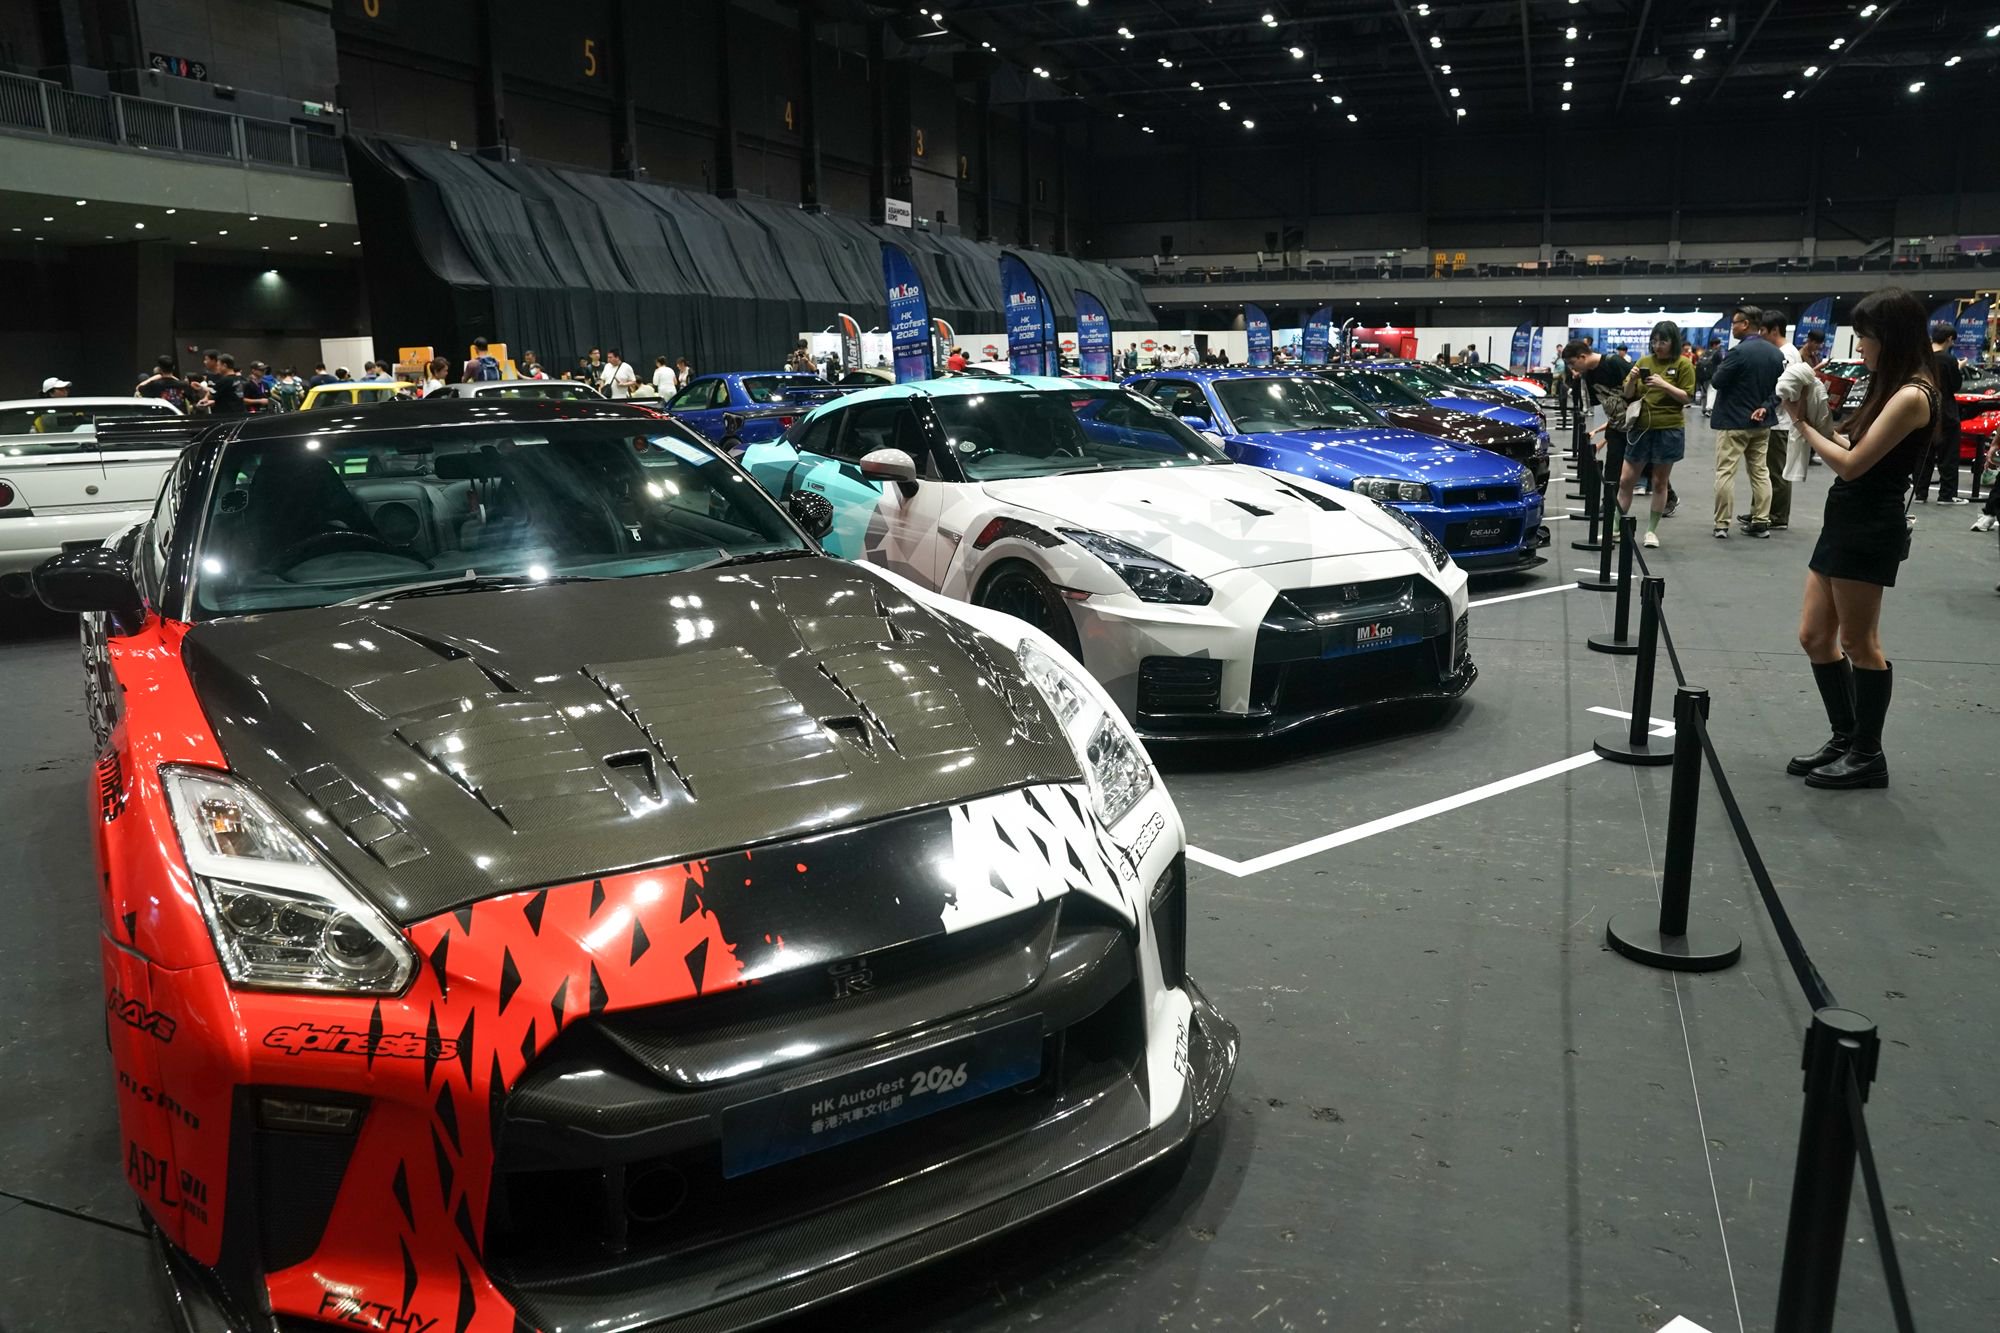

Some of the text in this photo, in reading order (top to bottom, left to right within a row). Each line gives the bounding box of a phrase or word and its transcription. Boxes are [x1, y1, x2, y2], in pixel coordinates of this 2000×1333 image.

[584, 39, 597, 77] 5
[785, 101, 793, 130] 4
[916, 129, 924, 156] 3
[961, 155, 968, 179] 2
[889, 283, 919, 299] MXpo
[891, 318, 926, 331] utofest
[900, 310, 913, 321] HK
[1020, 316, 1030, 324] HK
[895, 328, 919, 340] 2026
[1018, 331, 1035, 341] 2026
[1607, 328, 1619, 336] HK
[1356, 623, 1393, 641] IMXpo
[108, 986, 177, 1044] RAYS
[262, 1022, 464, 1060] alpinestars
[811, 1062, 968, 1117] HK Autofest 2026
[811, 1094, 903, 1135] 香港汽車文化節
